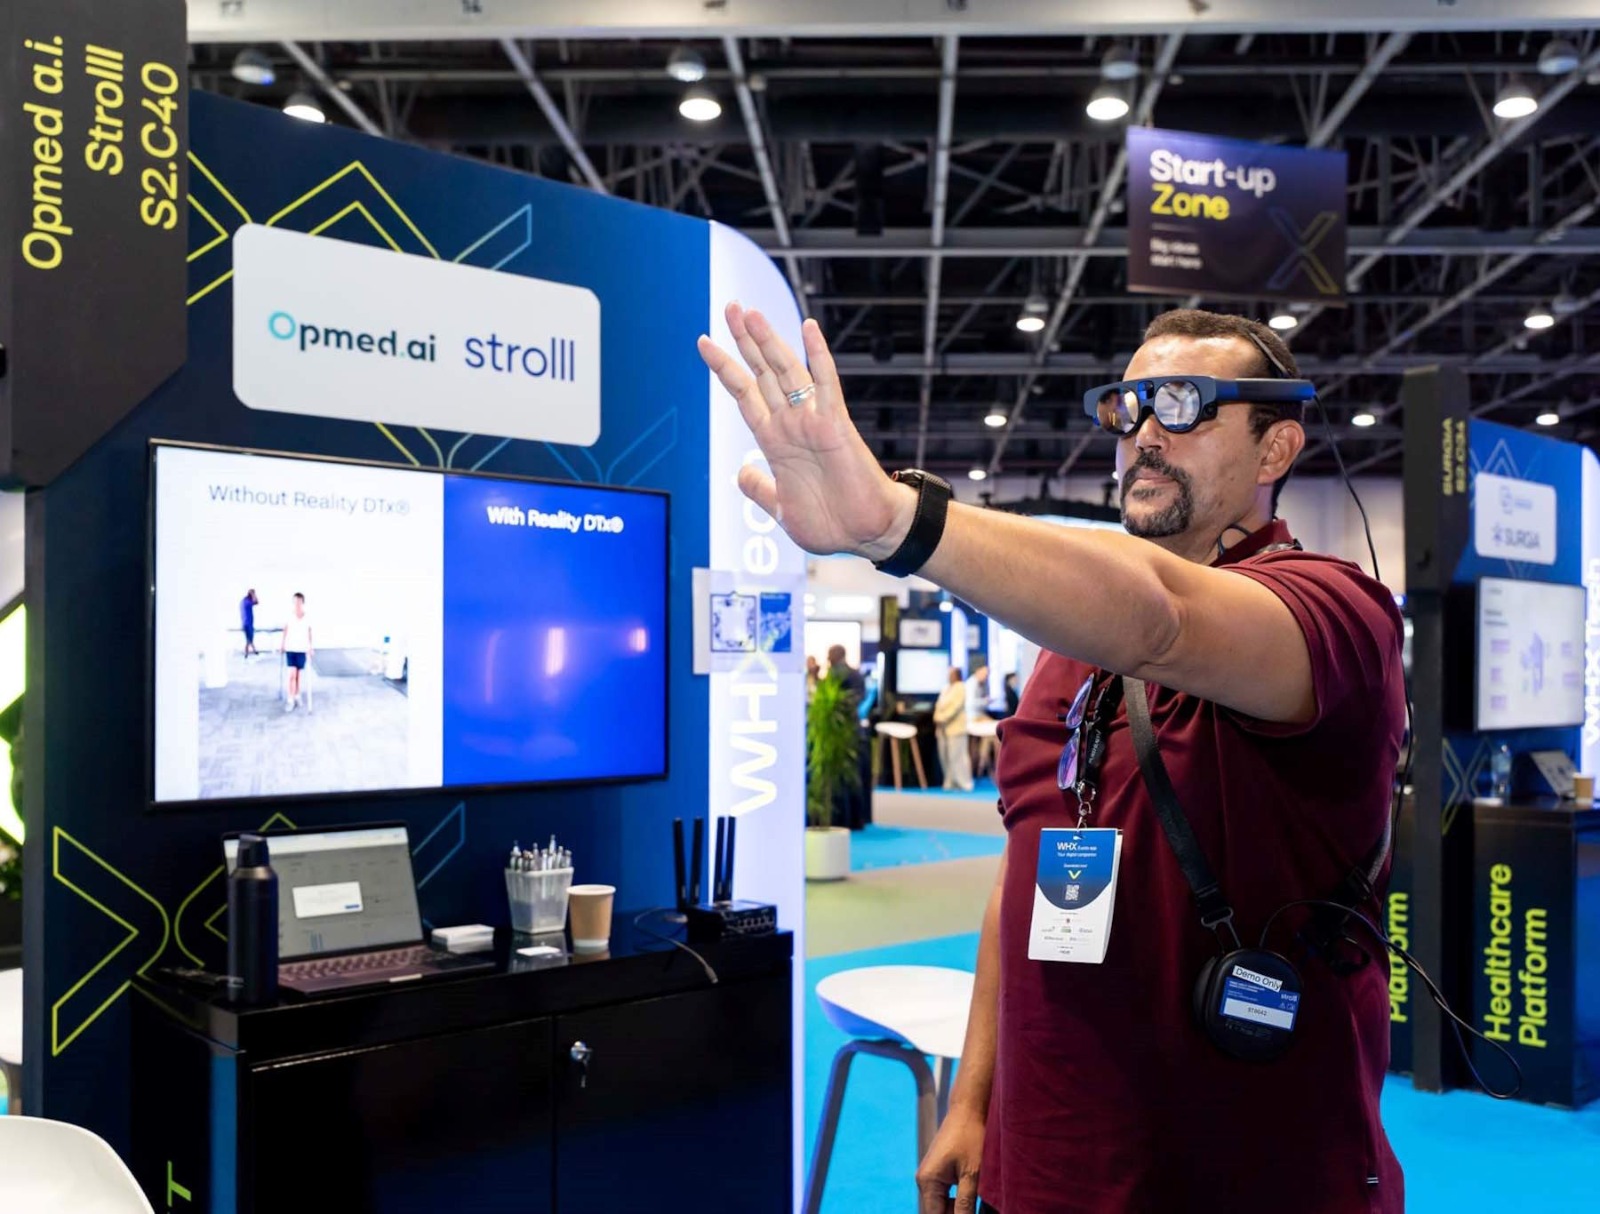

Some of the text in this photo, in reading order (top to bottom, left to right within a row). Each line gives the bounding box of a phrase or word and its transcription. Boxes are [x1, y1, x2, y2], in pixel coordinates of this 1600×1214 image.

[84, 43, 124, 176] Strolll
[140, 61, 179, 230] S2.C40
[22, 35, 73, 270] Opmed a.i.
[1150, 148, 1277, 198] Start-up
[1151, 183, 1231, 221] Zone
[268, 310, 576, 383] Opmed.ai strolll
[207, 485, 288, 507] Without
[293, 490, 359, 515] Reality
[486, 506, 526, 527] With
[527, 509, 582, 533] Reality
[730, 637, 779, 817] WHX
[1056, 842, 1078, 851] WHX
[1235, 967, 1260, 984] Demo
[1262, 976, 1281, 991] Only
[1484, 863, 1512, 1042] Healthcare
[1518, 908, 1548, 1048] Platform
